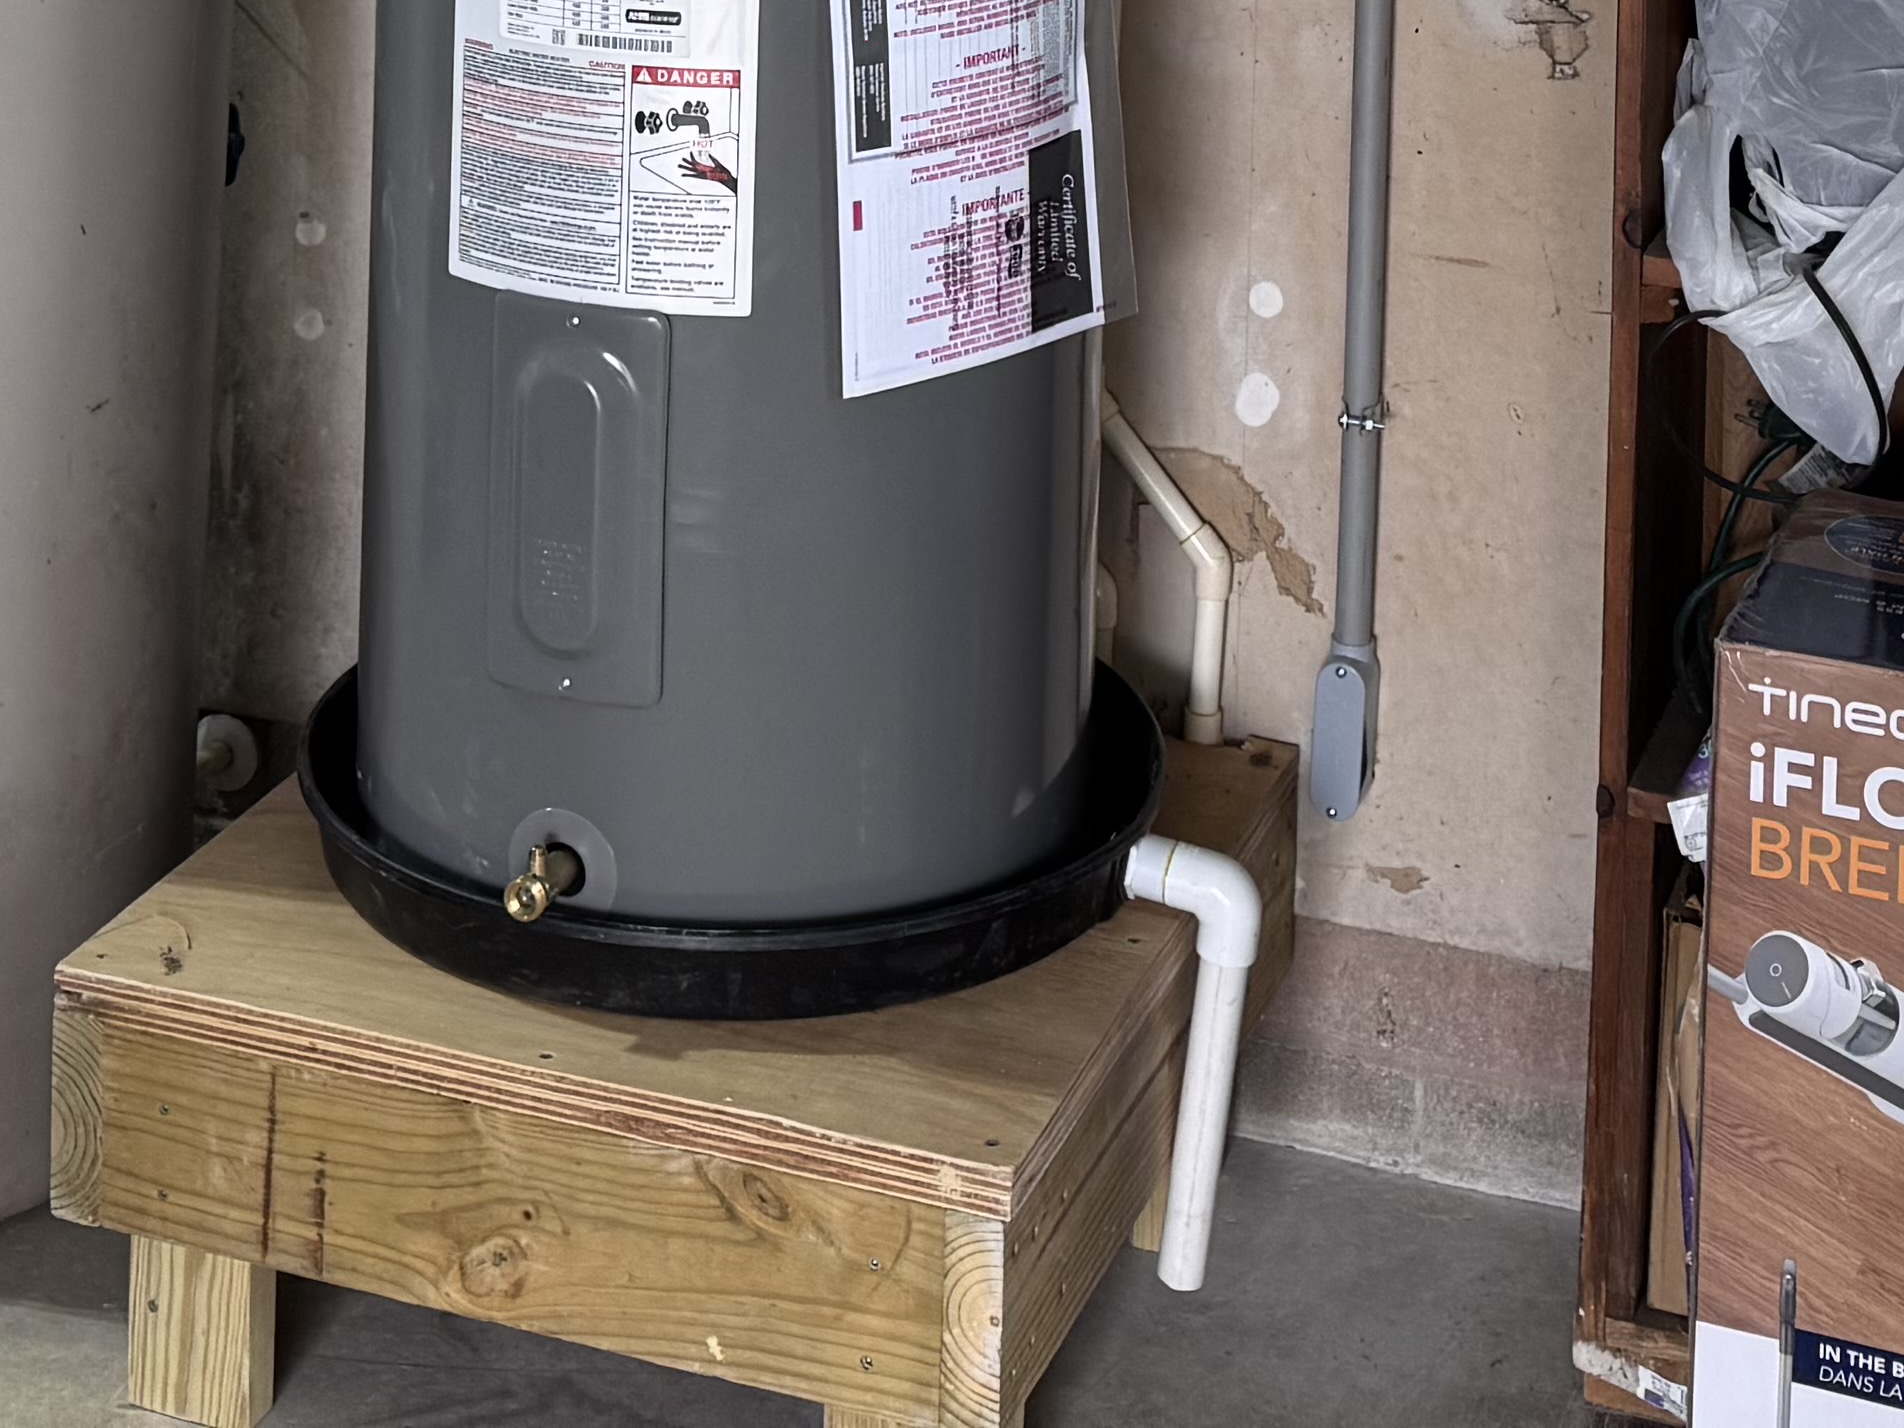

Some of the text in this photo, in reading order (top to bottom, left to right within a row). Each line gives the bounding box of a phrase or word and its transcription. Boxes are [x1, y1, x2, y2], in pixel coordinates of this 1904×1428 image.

[963, 44, 1019, 69] IMPORTANT
[657, 69, 733, 85] DANGER
[962, 188, 1025, 216] IMPORTANTE
[1049, 200, 1064, 262] Limited
[1061, 173, 1082, 281] Certificate of
[1818, 1343, 1841, 1364] IN
[1846, 1348, 1886, 1375] THE
[1819, 1365, 1875, 1394] DANS
[1880, 1379, 1903, 1398] LA
